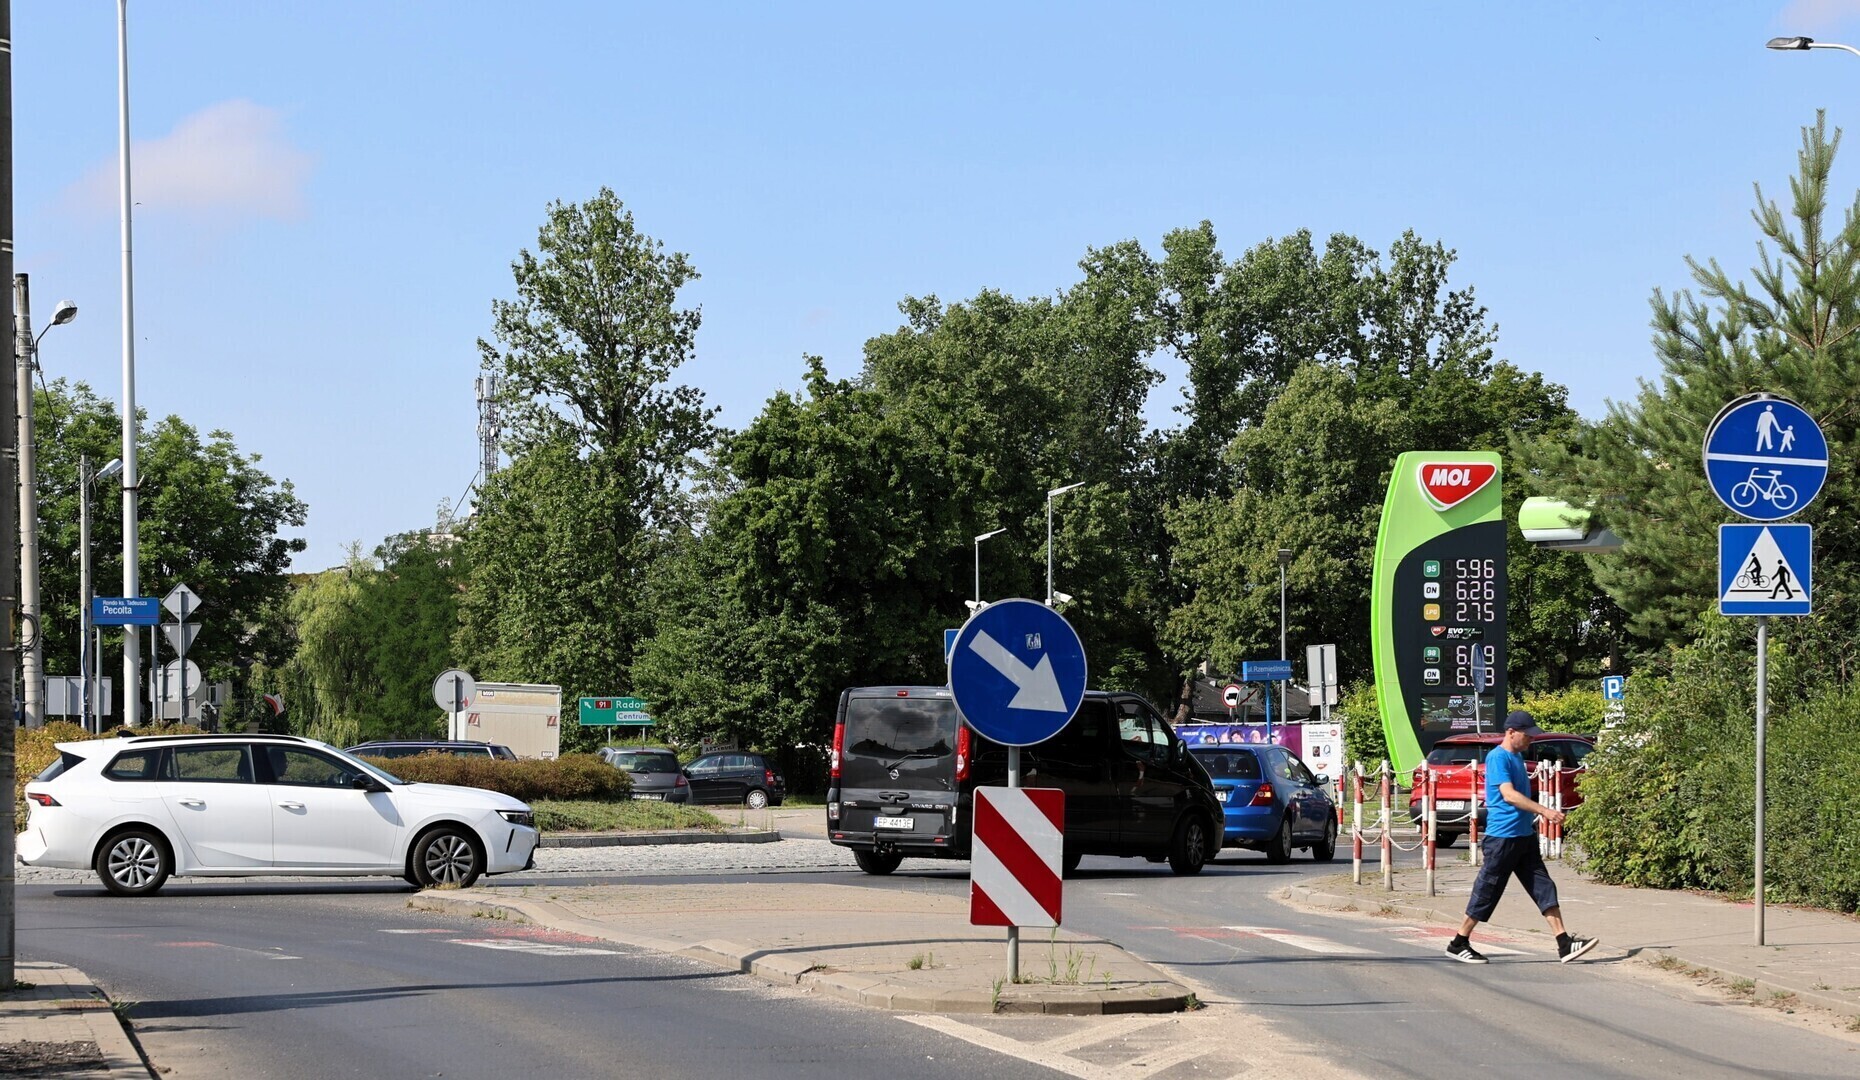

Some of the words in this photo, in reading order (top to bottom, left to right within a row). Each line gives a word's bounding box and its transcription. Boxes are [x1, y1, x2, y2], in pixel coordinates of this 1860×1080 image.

[1429, 468, 1471, 486] MOL
[1426, 565, 1437, 573] 95
[1456, 559, 1495, 578] 5.96
[1426, 586, 1437, 594] ON
[1456, 581, 1495, 600] 6.26
[103, 606, 132, 614] Pecolta
[1456, 602, 1495, 622] 2.75
[1456, 645, 1495, 665] 6.9
[1456, 667, 1495, 686] 6.9
[1607, 678, 1620, 699] P
[878, 818, 888, 827] EP
[890, 818, 912, 828] 4413E
